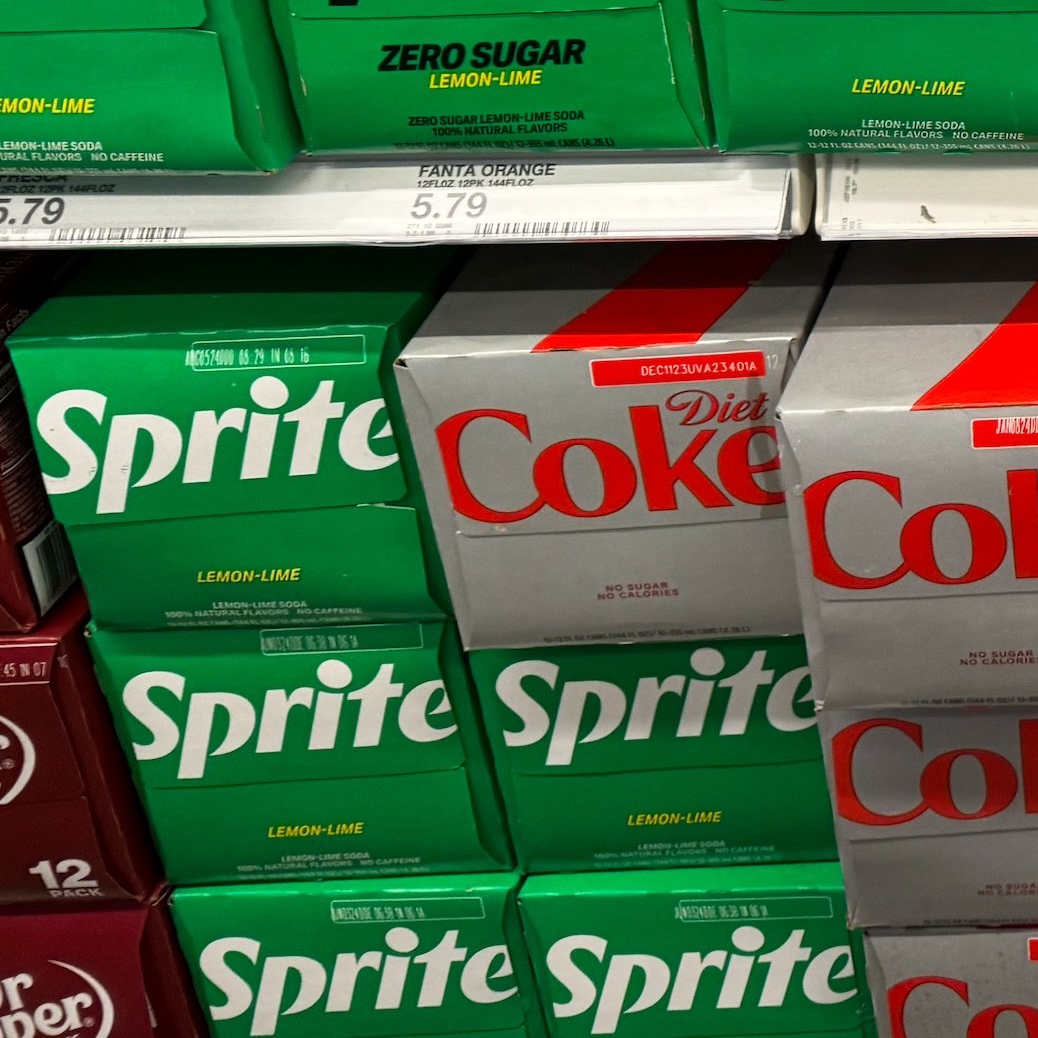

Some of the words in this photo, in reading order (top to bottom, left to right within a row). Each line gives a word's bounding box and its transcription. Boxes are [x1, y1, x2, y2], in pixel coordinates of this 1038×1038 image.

[378, 43, 465, 73] ZERO
[469, 39, 586, 69] SUGAR
[428, 70, 543, 90] LEMON-LIME
[851, 78, 966, 97] LEMON-LIME
[418, 164, 476, 178] FANTA
[481, 163, 557, 177] ORANGE
[457, 179, 485, 188] 12PK
[487, 178, 535, 187] 144FLOZ
[410, 192, 488, 220] 5.79
[666, 389, 769, 426] Diet
[36, 375, 400, 515] Sprite
[435, 405, 787, 524] Coke
[197, 567, 301, 584] LEMON-LIME
[605, 584, 624, 593] NO
[627, 581, 668, 592] SUGAR
[597, 591, 615, 601] NO
[618, 588, 680, 599] CALORIES
[495, 647, 819, 765] Sprite
[122, 659, 458, 779] Sprite
[267, 822, 364, 838] LEMON-LIME
[627, 810, 722, 826] LEMON-LIME
[29, 858, 98, 890] 12
[50, 888, 102, 898] PACK
[199, 926, 519, 1037] Sprite
[546, 925, 858, 1035] Sprite
